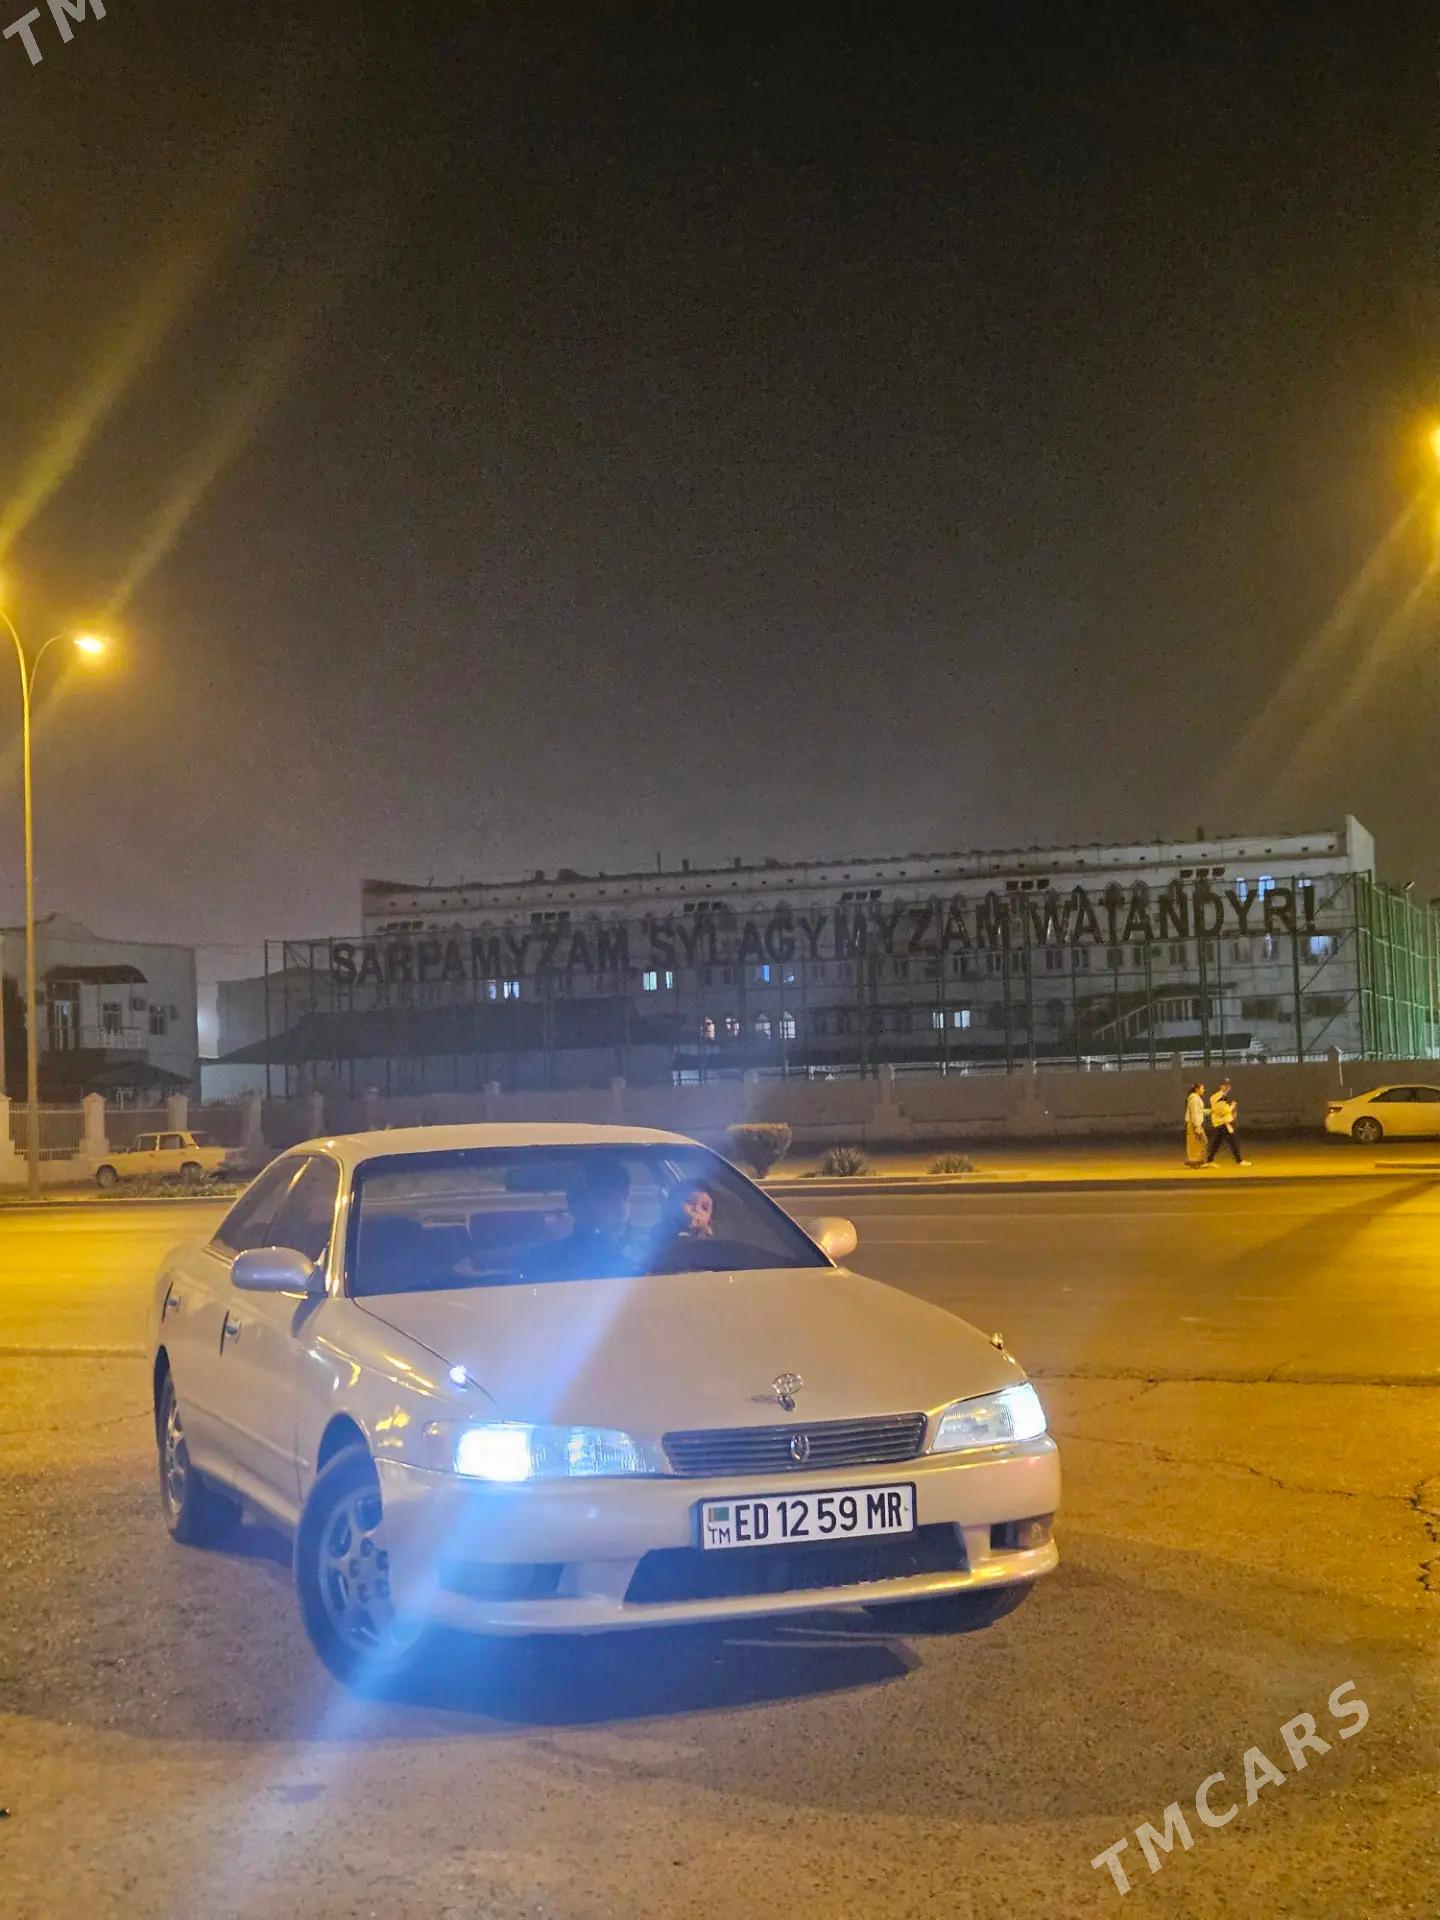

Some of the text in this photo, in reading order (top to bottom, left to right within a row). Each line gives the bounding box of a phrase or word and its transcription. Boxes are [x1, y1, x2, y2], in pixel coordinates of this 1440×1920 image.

[1030, 885, 1316, 946] WATANDYR!
[709, 1526, 731, 1545] TM
[735, 1503, 770, 1542] ED
[866, 1491, 903, 1530] MR
